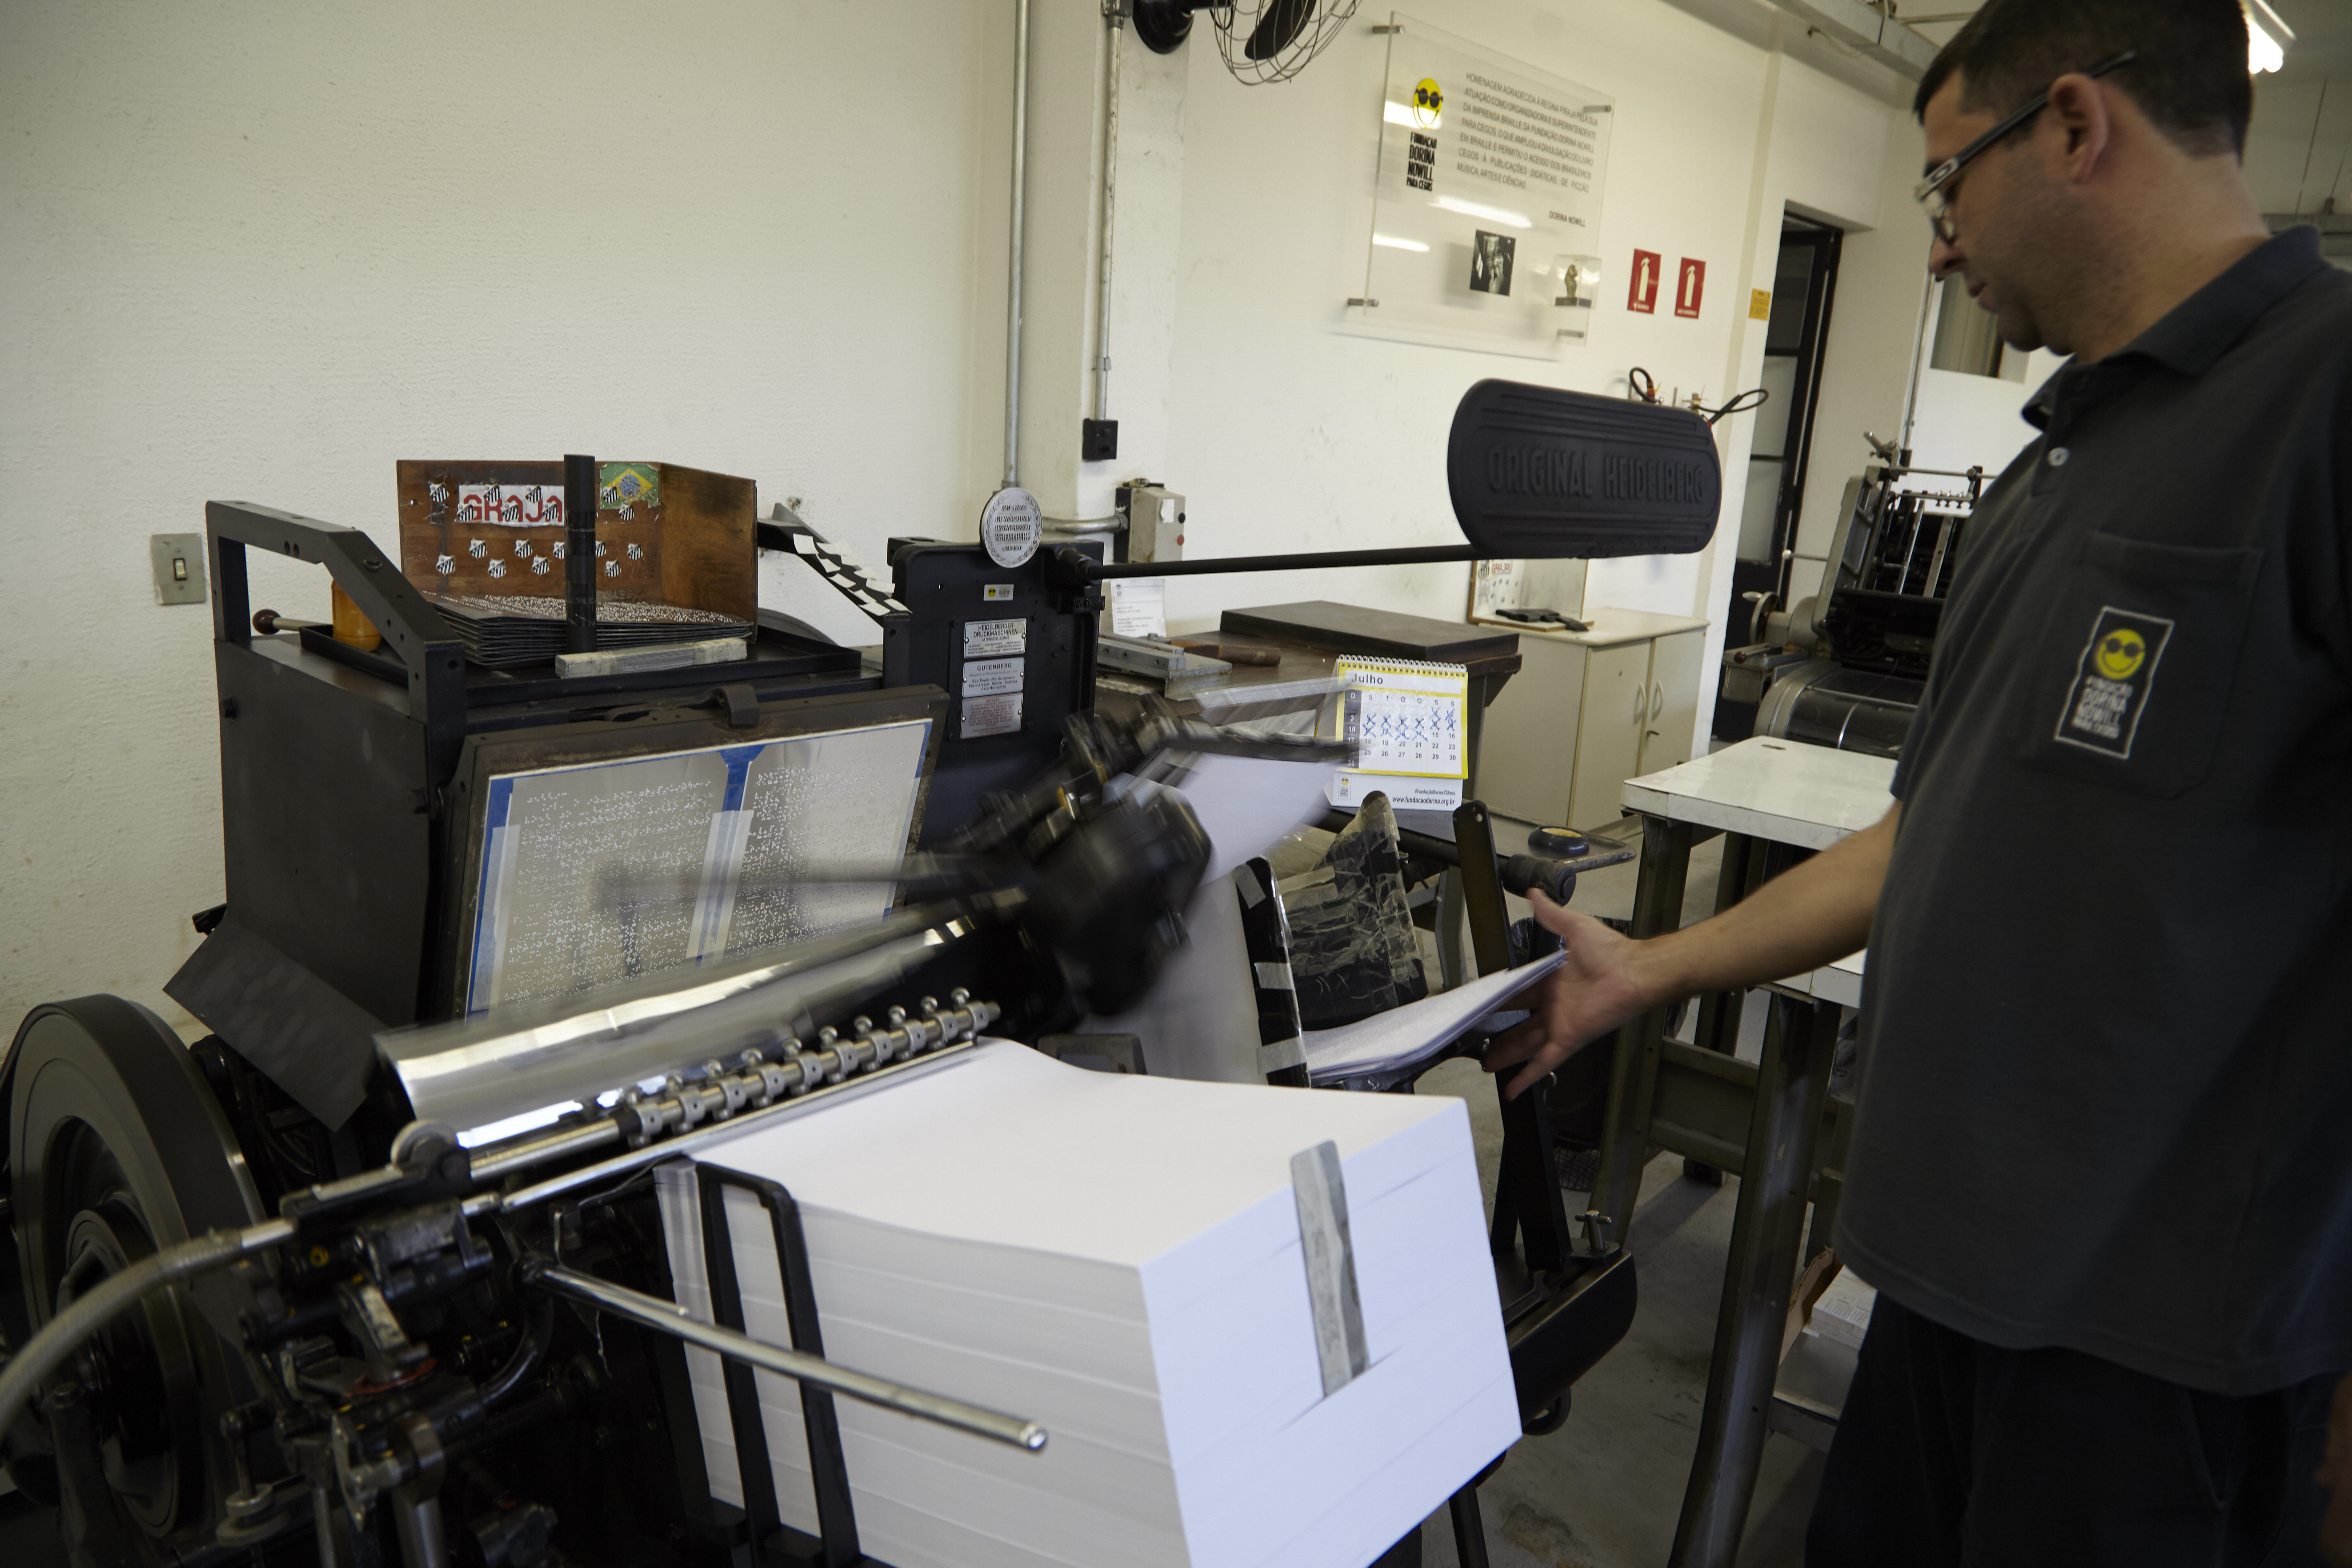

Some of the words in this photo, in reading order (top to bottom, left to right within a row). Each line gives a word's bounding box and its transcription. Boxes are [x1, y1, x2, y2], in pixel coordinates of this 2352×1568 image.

[1467, 72, 1502, 92] HOMENAGEM
[1503, 86, 1536, 103] AGRADECIDA
[1541, 100, 1558, 112] REGINA
[1577, 113, 1589, 122] PELA
[1589, 117, 1598, 126] SUA
[1465, 87, 1491, 105] ATUAÇÃO
[1491, 98, 1508, 110] COMO
[1508, 103, 1547, 123] ORGANIZADORA
[1553, 119, 1596, 139] SUPERINTENDENTE
[1463, 103, 1471, 112] DA
[1473, 106, 1500, 121] IMPRENSA
[1501, 116, 1522, 129] BRAILLE
[1523, 123, 1531, 132] DA
[1531, 125, 1558, 142] FUNDAÇÃO
[1558, 134, 1576, 146] DORINA
[1577, 141, 1594, 153] NOWILL
[1462, 119, 1476, 130] PARA
[1503, 132, 1514, 141] QUE
[1514, 135, 1537, 148] AMPLIOU
[1541, 143, 1572, 160] DIVULGAÇÃO
[1580, 156, 1593, 166] LIVRO
[1409, 144, 1435, 165] DORINA
[1458, 148, 1479, 161] CEGOS
[1490, 156, 1527, 175] PUBLICAÇÕES
[1460, 134, 1469, 143] EM
[1470, 137, 1492, 150] BRAILLE
[1498, 144, 1523, 158] PERMITIU
[1529, 154, 1550, 167] ACESSO
[1550, 161, 1560, 170] DOS
[1562, 165, 1591, 179] BRASILEIROS
[1408, 161, 1433, 181] NOWILL
[1480, 169, 1498, 181] ARTES
[1550, 211, 1567, 222] DORINA
[1569, 216, 1585, 227] NOWILL
[1489, 447, 1592, 498] ORIGINAL
[1605, 454, 1706, 503] HEIDELBERG
[1003, 514, 1031, 522] MÁQUINAS
[995, 533, 1030, 541] HEIDELBERG
[973, 629, 1018, 637] DRUCKMASCHINEN
[977, 663, 1011, 671] GUTENBERG
[1352, 673, 1383, 684] Julho
[1393, 796, 1455, 806] www.fundacaodorina.org.br
